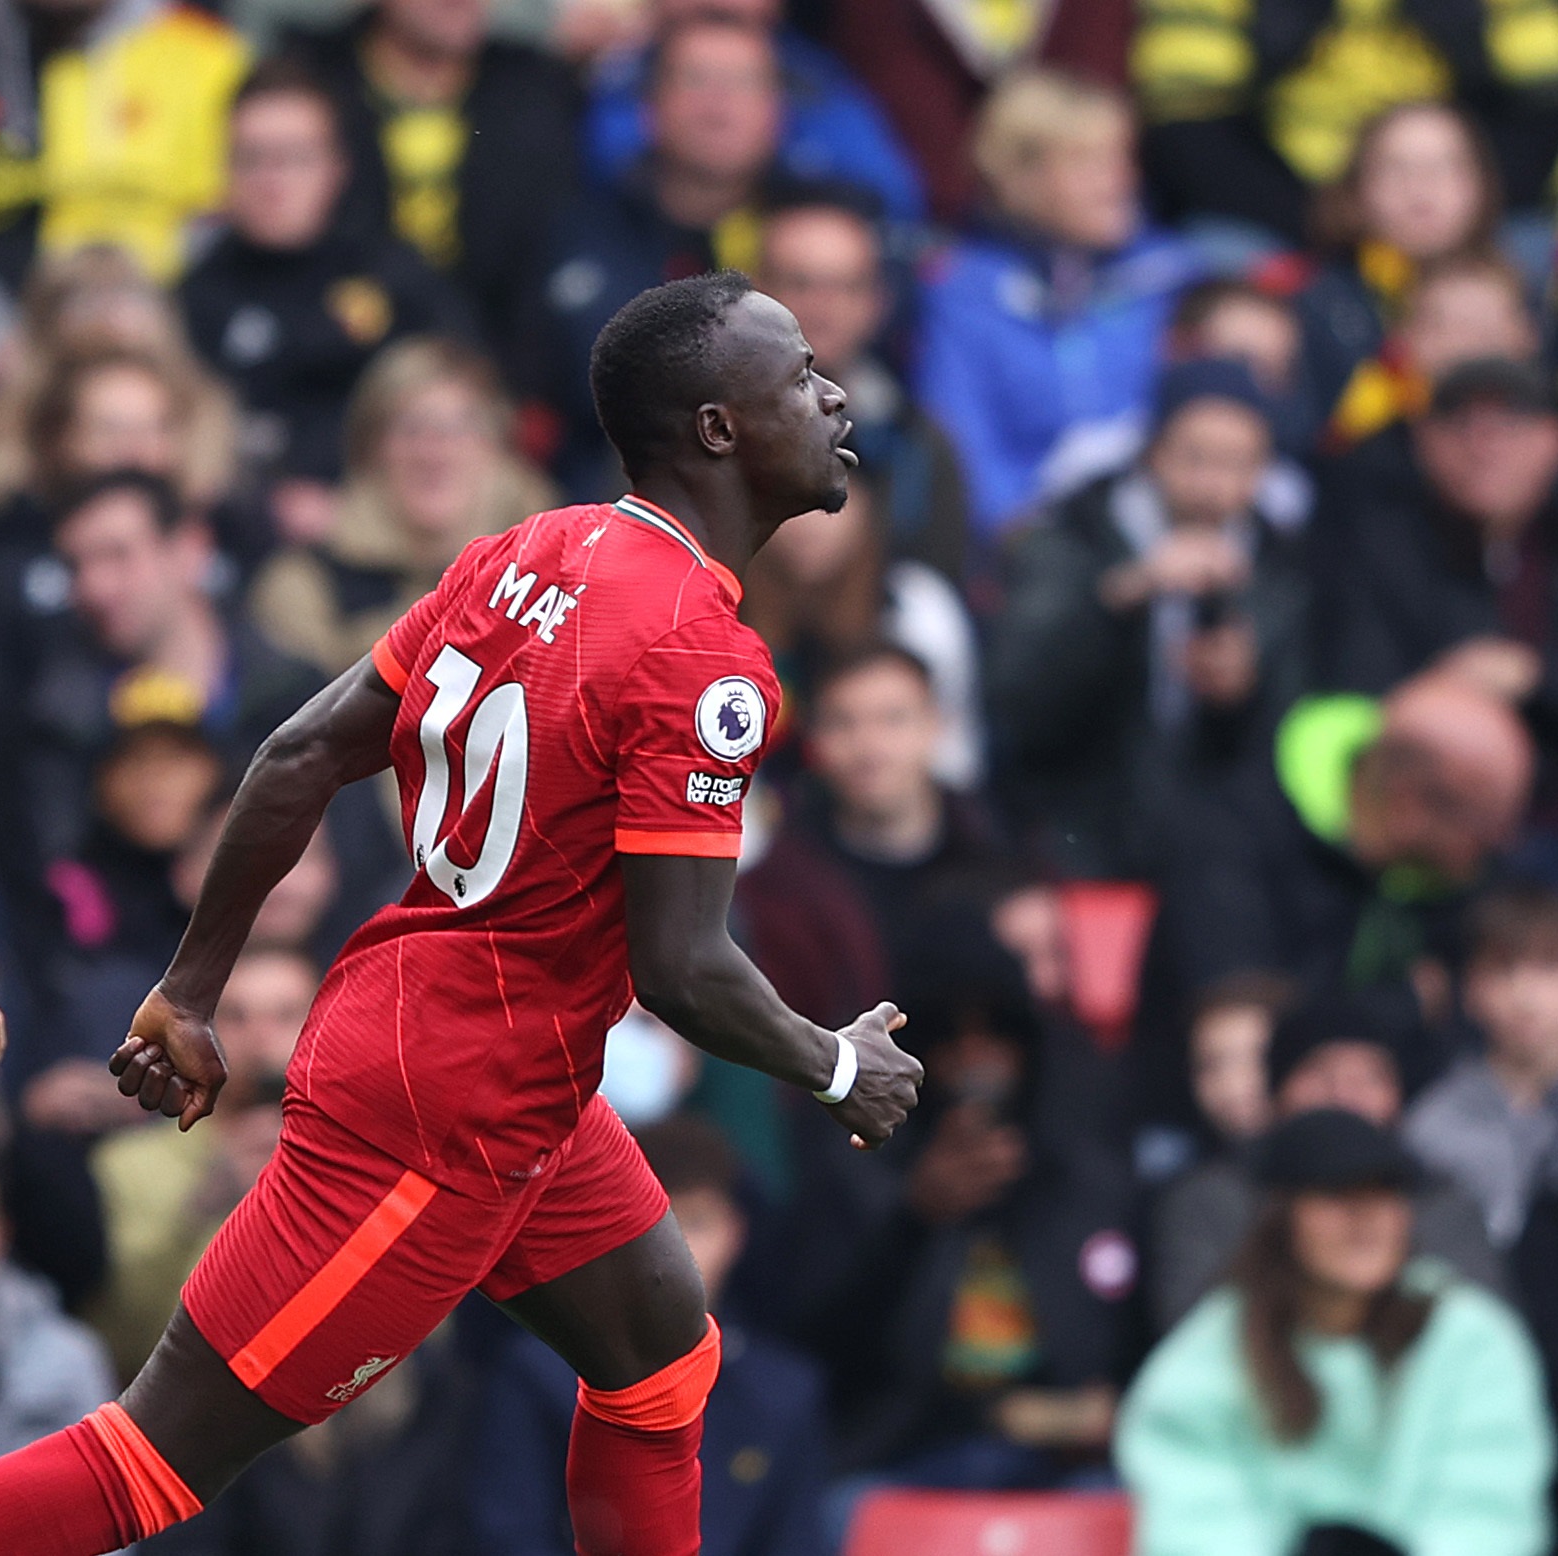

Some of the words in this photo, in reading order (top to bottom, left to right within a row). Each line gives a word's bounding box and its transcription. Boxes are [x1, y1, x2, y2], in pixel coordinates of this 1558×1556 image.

[413, 644, 529, 909] 10
[688, 772, 712, 789] No
[687, 786, 709, 803] for
